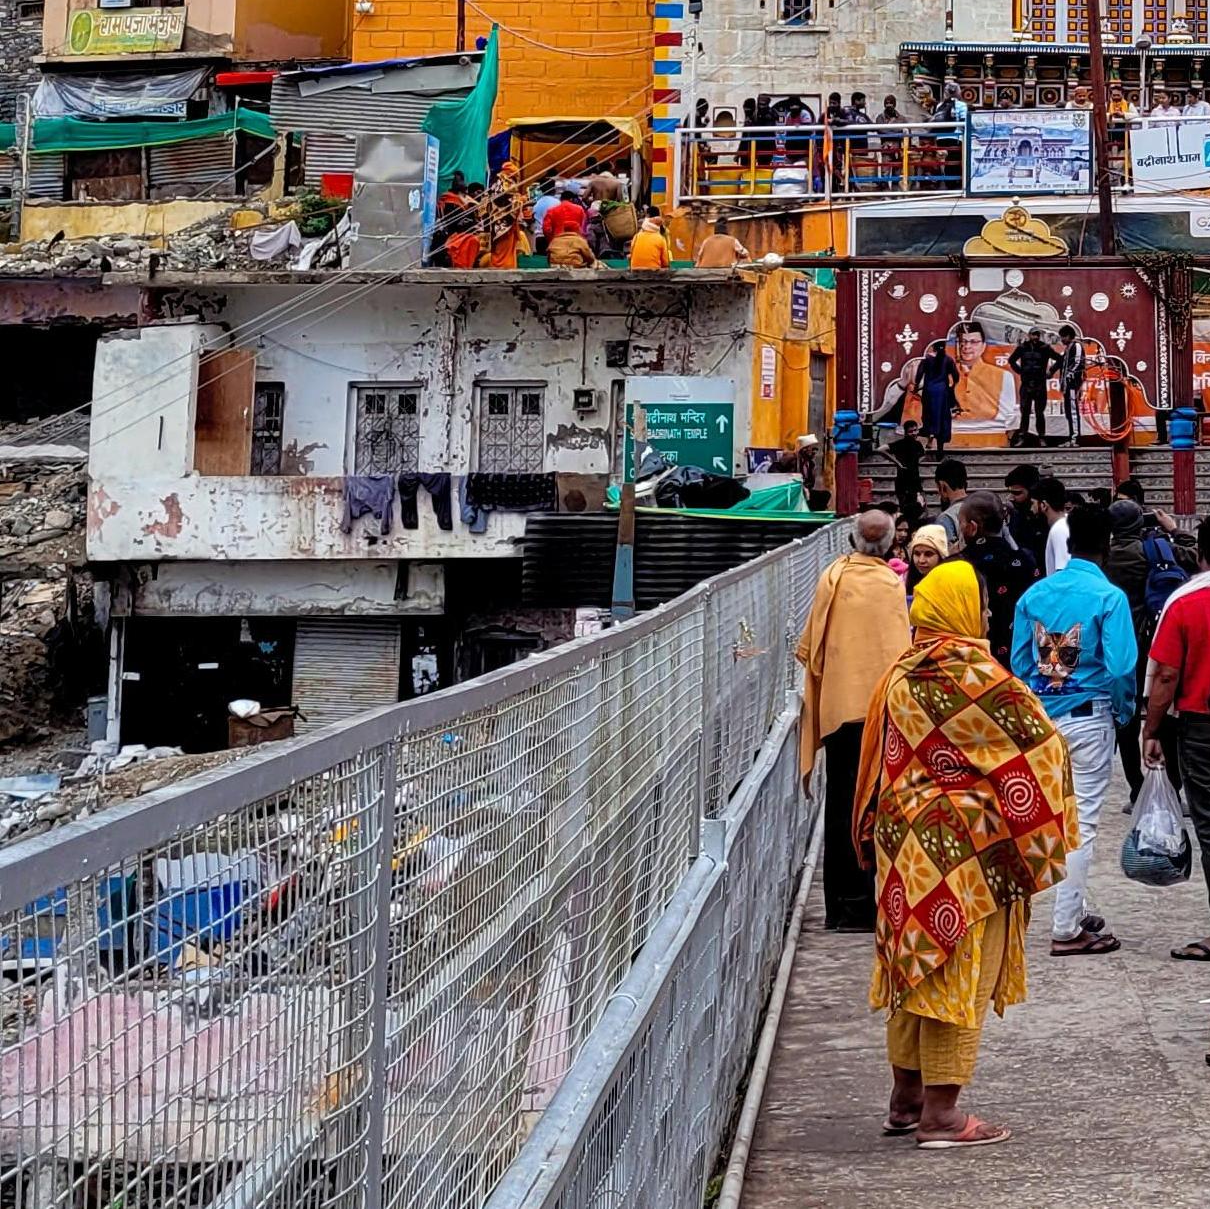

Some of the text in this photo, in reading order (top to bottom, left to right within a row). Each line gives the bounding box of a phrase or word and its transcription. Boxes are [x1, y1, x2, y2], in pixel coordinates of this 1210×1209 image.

[1136, 153, 1176, 167] बद्रीनाथ
[680, 409, 706, 424] मन्दिर
[684, 428, 708, 440] TEMPLE
